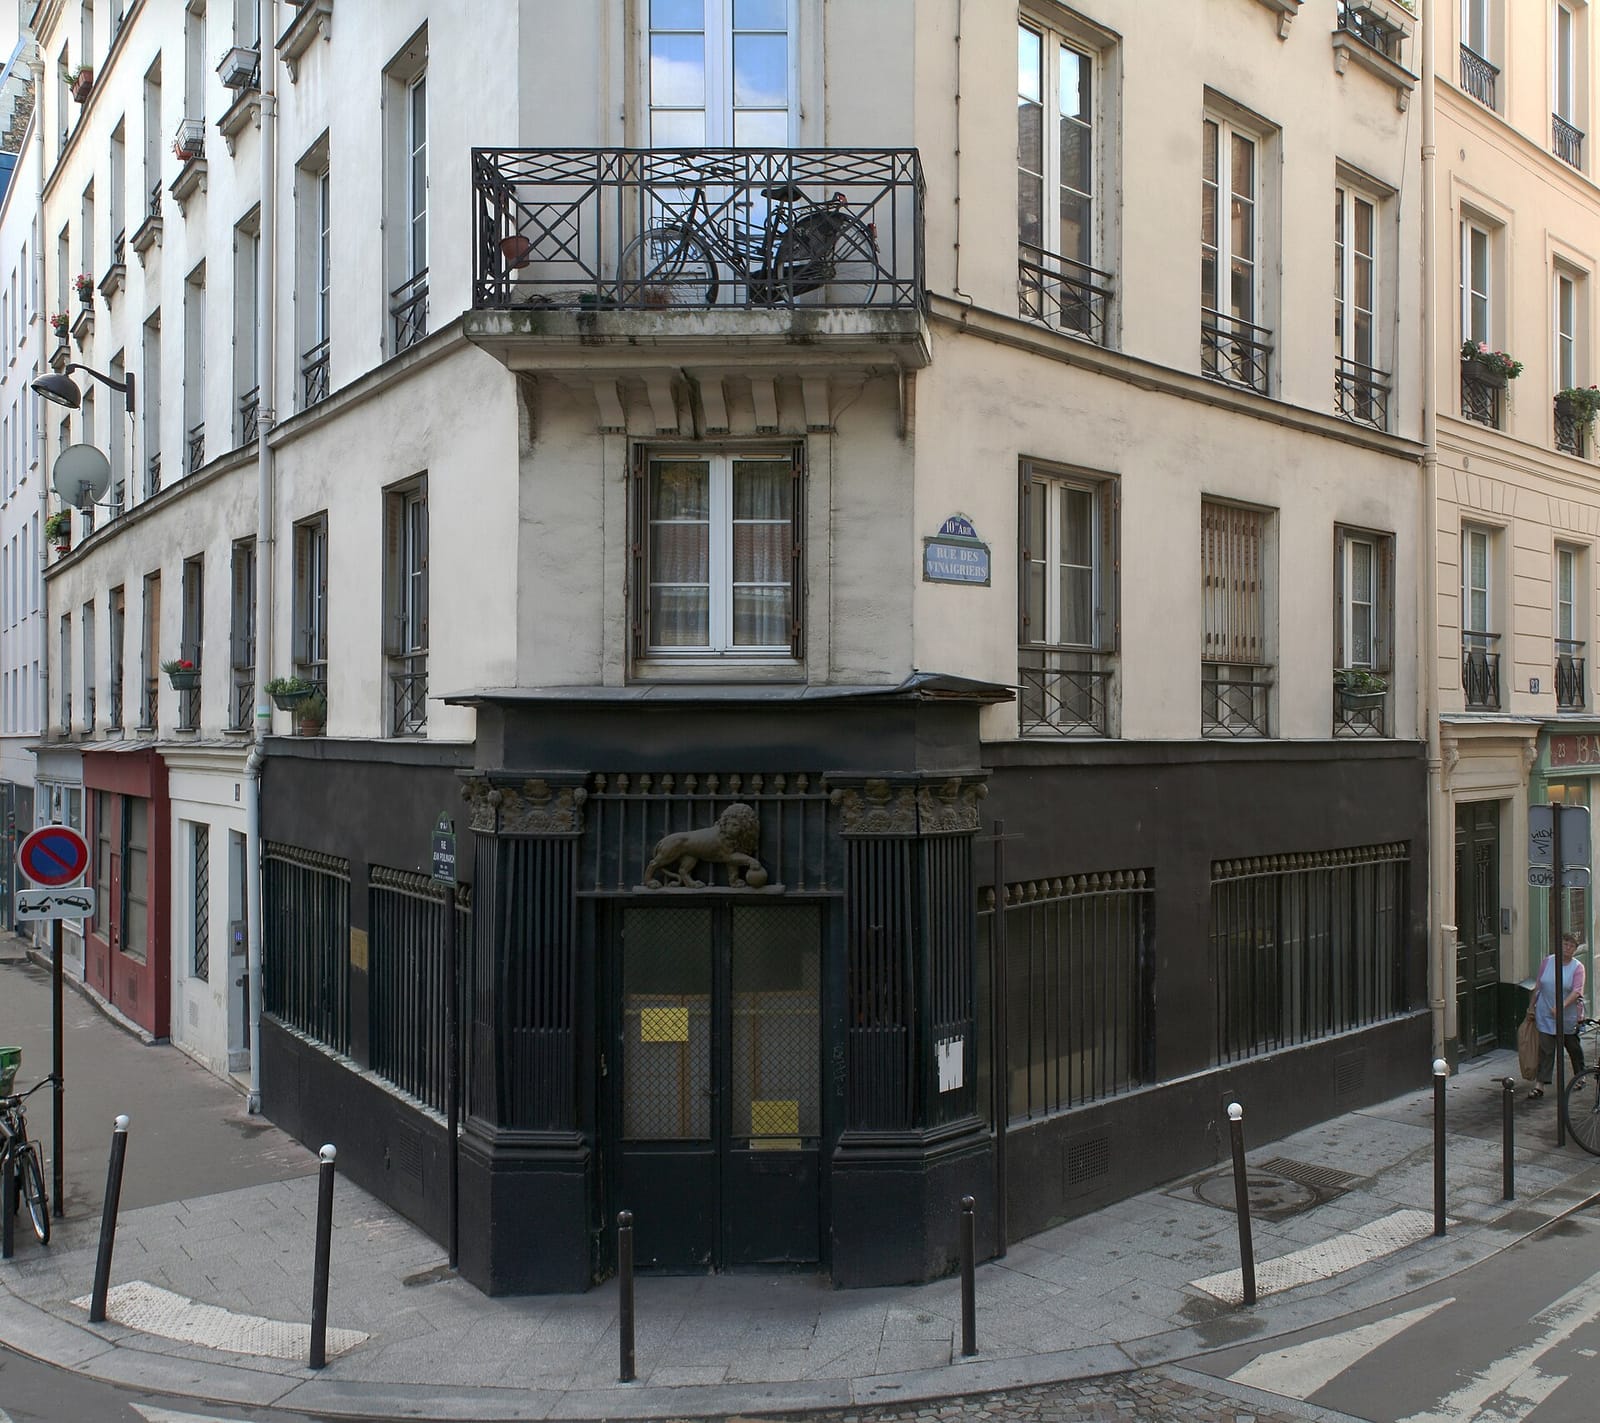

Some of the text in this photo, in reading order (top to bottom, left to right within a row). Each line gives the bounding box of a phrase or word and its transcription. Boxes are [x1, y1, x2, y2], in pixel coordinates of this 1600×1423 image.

[936, 547, 979, 562] RUE DES
[927, 560, 987, 577] VINAIGRIERS
[1557, 743, 1566, 758] 23
